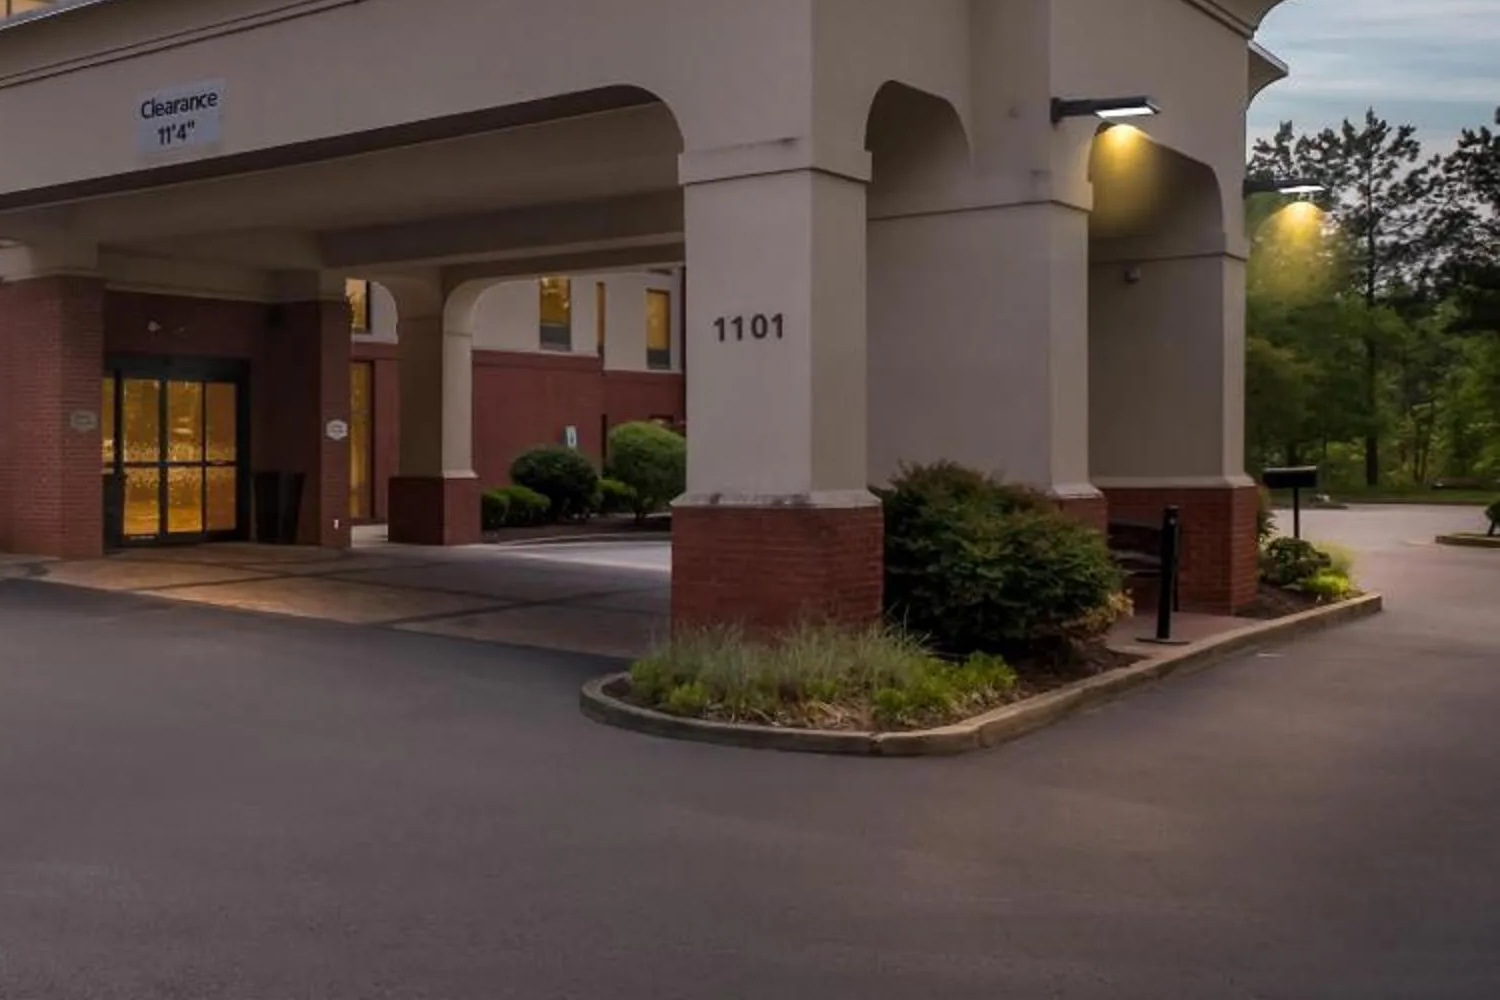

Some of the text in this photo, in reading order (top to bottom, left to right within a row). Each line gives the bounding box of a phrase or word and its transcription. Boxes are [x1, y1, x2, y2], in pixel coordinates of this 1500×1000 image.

[141, 92, 218, 119] Clearance
[158, 120, 195, 145] 11'4"
[713, 312, 783, 342] 1101
